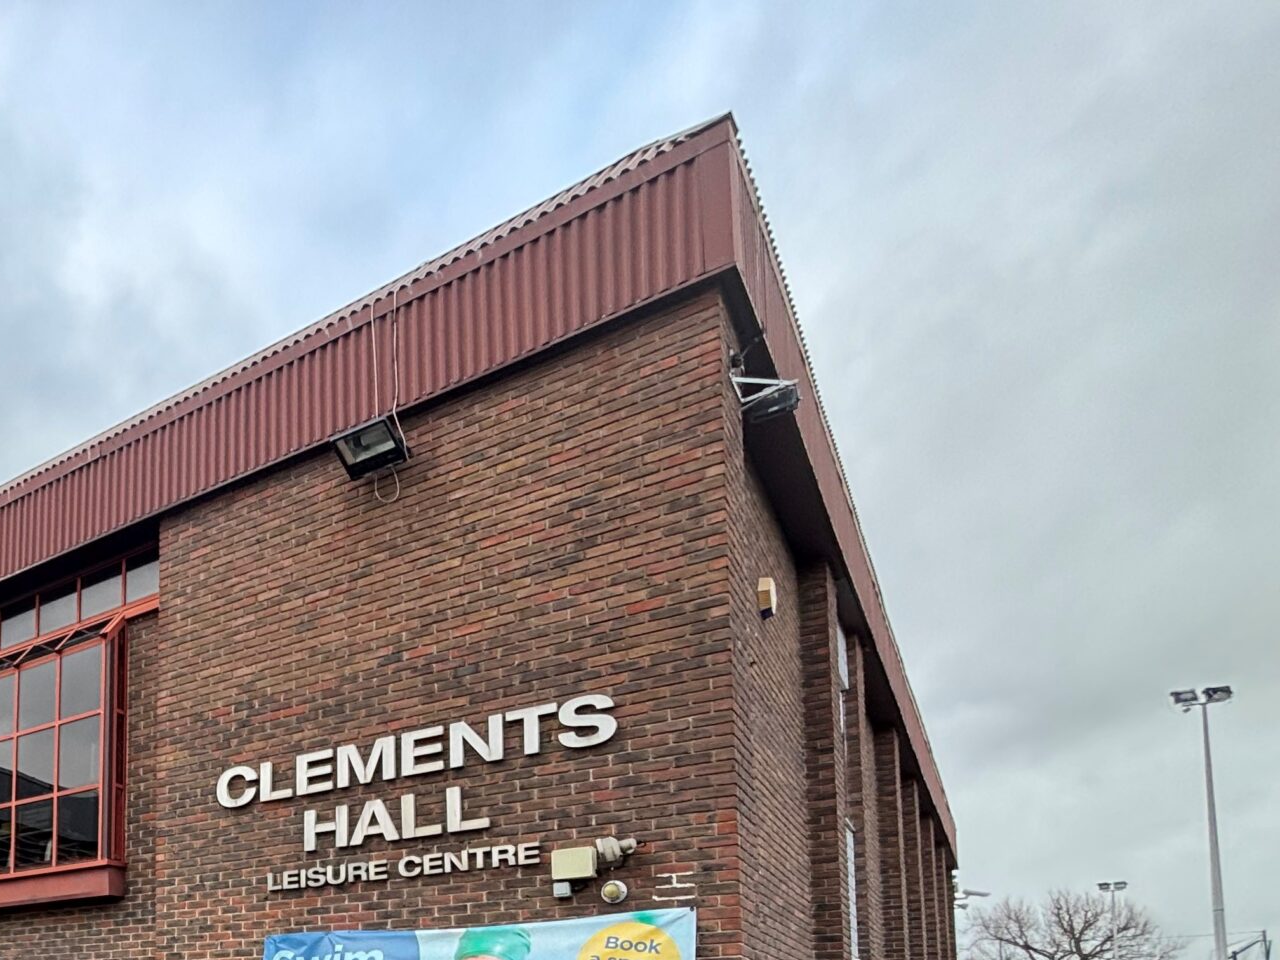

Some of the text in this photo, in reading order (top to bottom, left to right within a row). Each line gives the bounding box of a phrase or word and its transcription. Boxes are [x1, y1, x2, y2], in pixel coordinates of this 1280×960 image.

[216, 694, 618, 808] CLEMENTS
[303, 786, 491, 852] HALL
[267, 842, 540, 891] LEISURE CENTRE
[605, 936, 662, 954] Book
